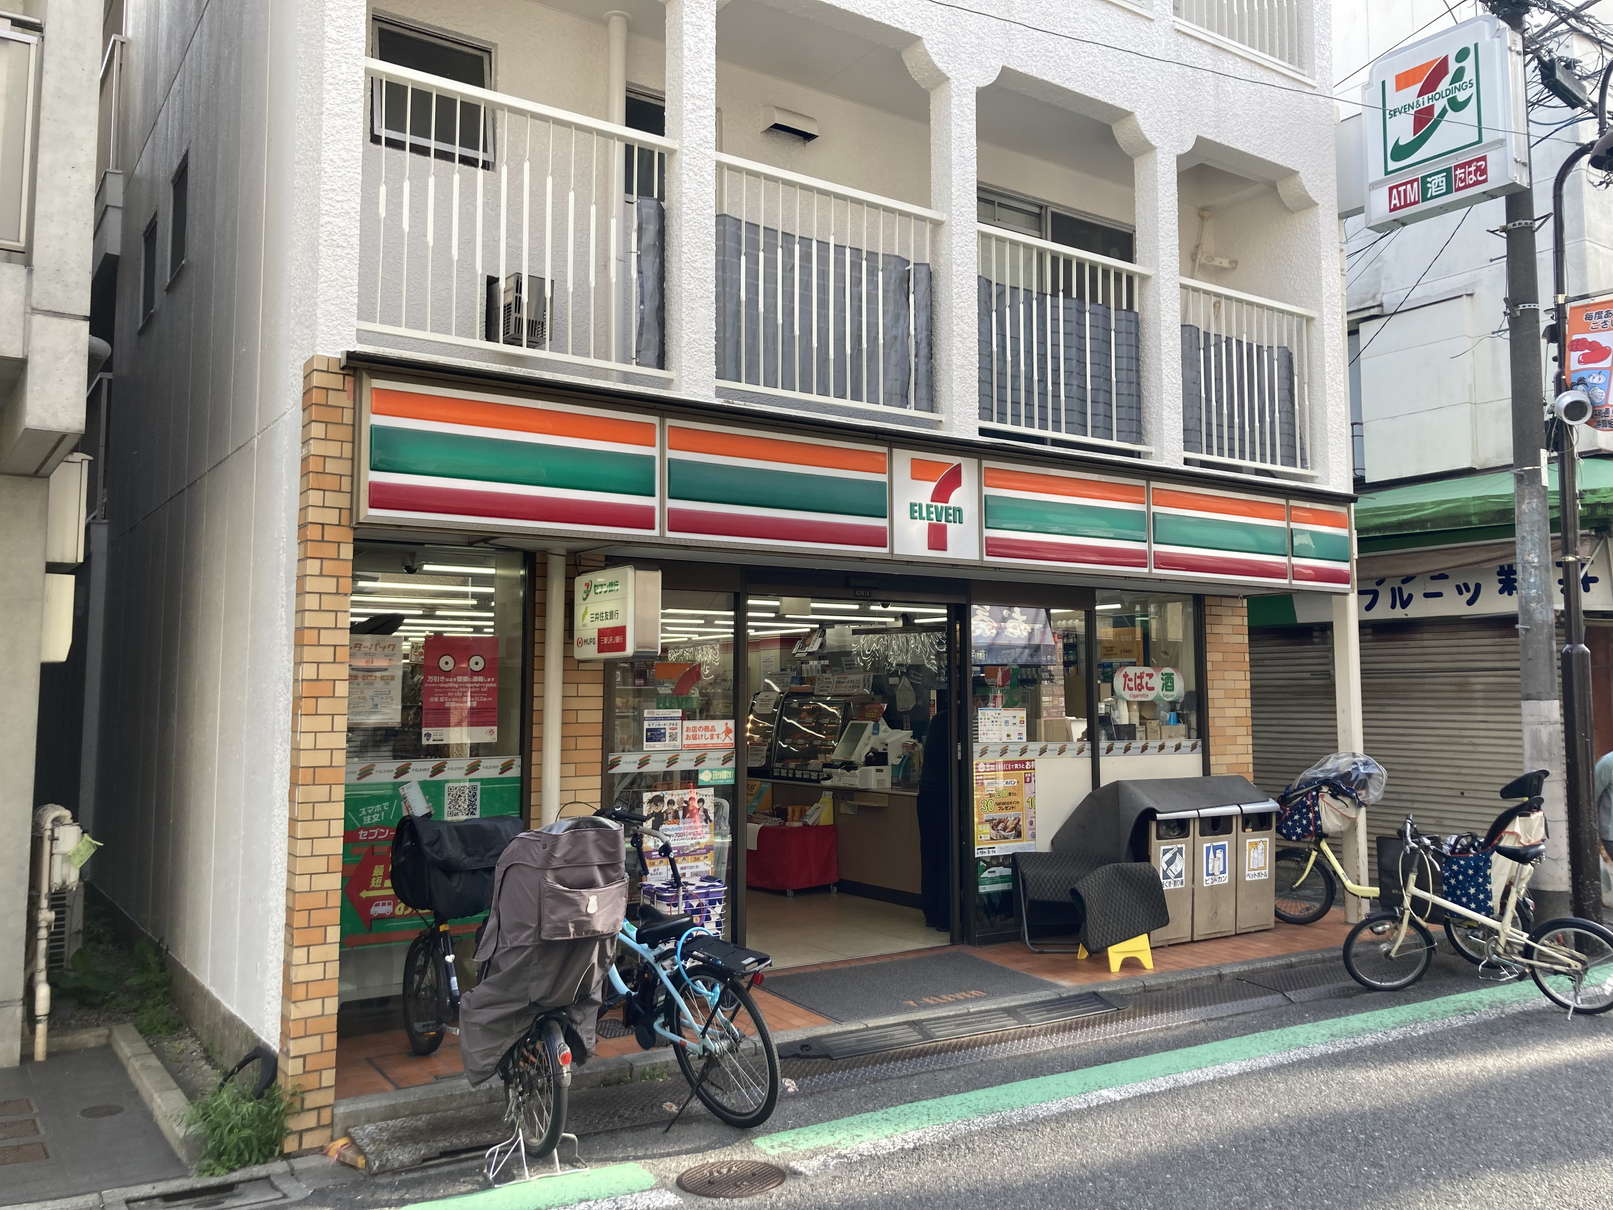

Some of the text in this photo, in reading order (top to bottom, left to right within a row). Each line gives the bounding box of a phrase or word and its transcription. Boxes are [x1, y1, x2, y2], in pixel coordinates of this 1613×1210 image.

[1427, 79, 1474, 105] HOLDINGS
[1390, 161, 1487, 209] ATM 酒 たばこ
[1122, 670, 1175, 692] たばこ 酒
